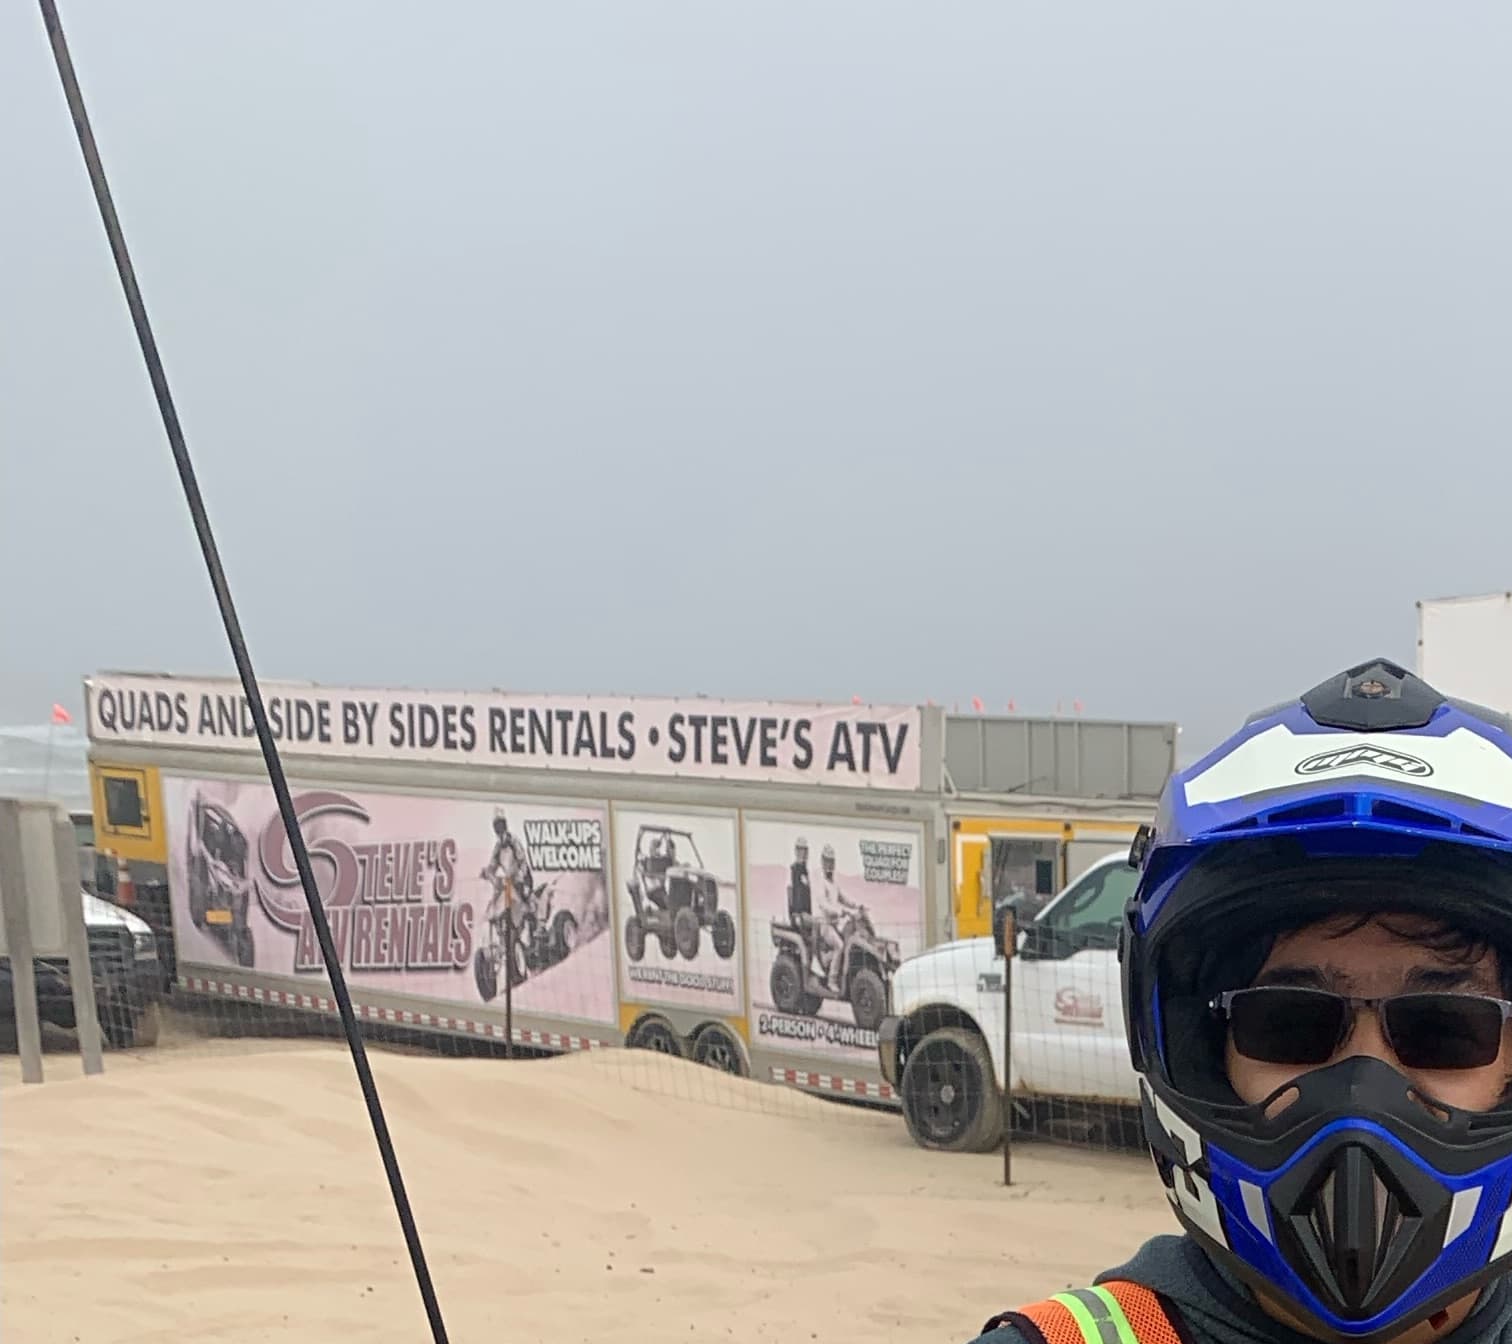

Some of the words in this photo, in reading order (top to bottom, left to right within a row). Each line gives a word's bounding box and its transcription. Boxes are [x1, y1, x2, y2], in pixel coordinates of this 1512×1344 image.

[98, 687, 189, 734] QUADS
[199, 693, 257, 738] AND
[270, 697, 331, 744] SIDE
[342, 700, 379, 746] BY
[389, 703, 476, 752] SIDES
[488, 707, 636, 761] RENTALS
[667, 712, 814, 770] STEVE'S
[826, 719, 909, 774] ATV
[524, 819, 602, 845] WALK-UPS
[528, 845, 602, 871] WELCOME
[294, 905, 351, 971] AV
[352, 901, 474, 971] RENTALS
